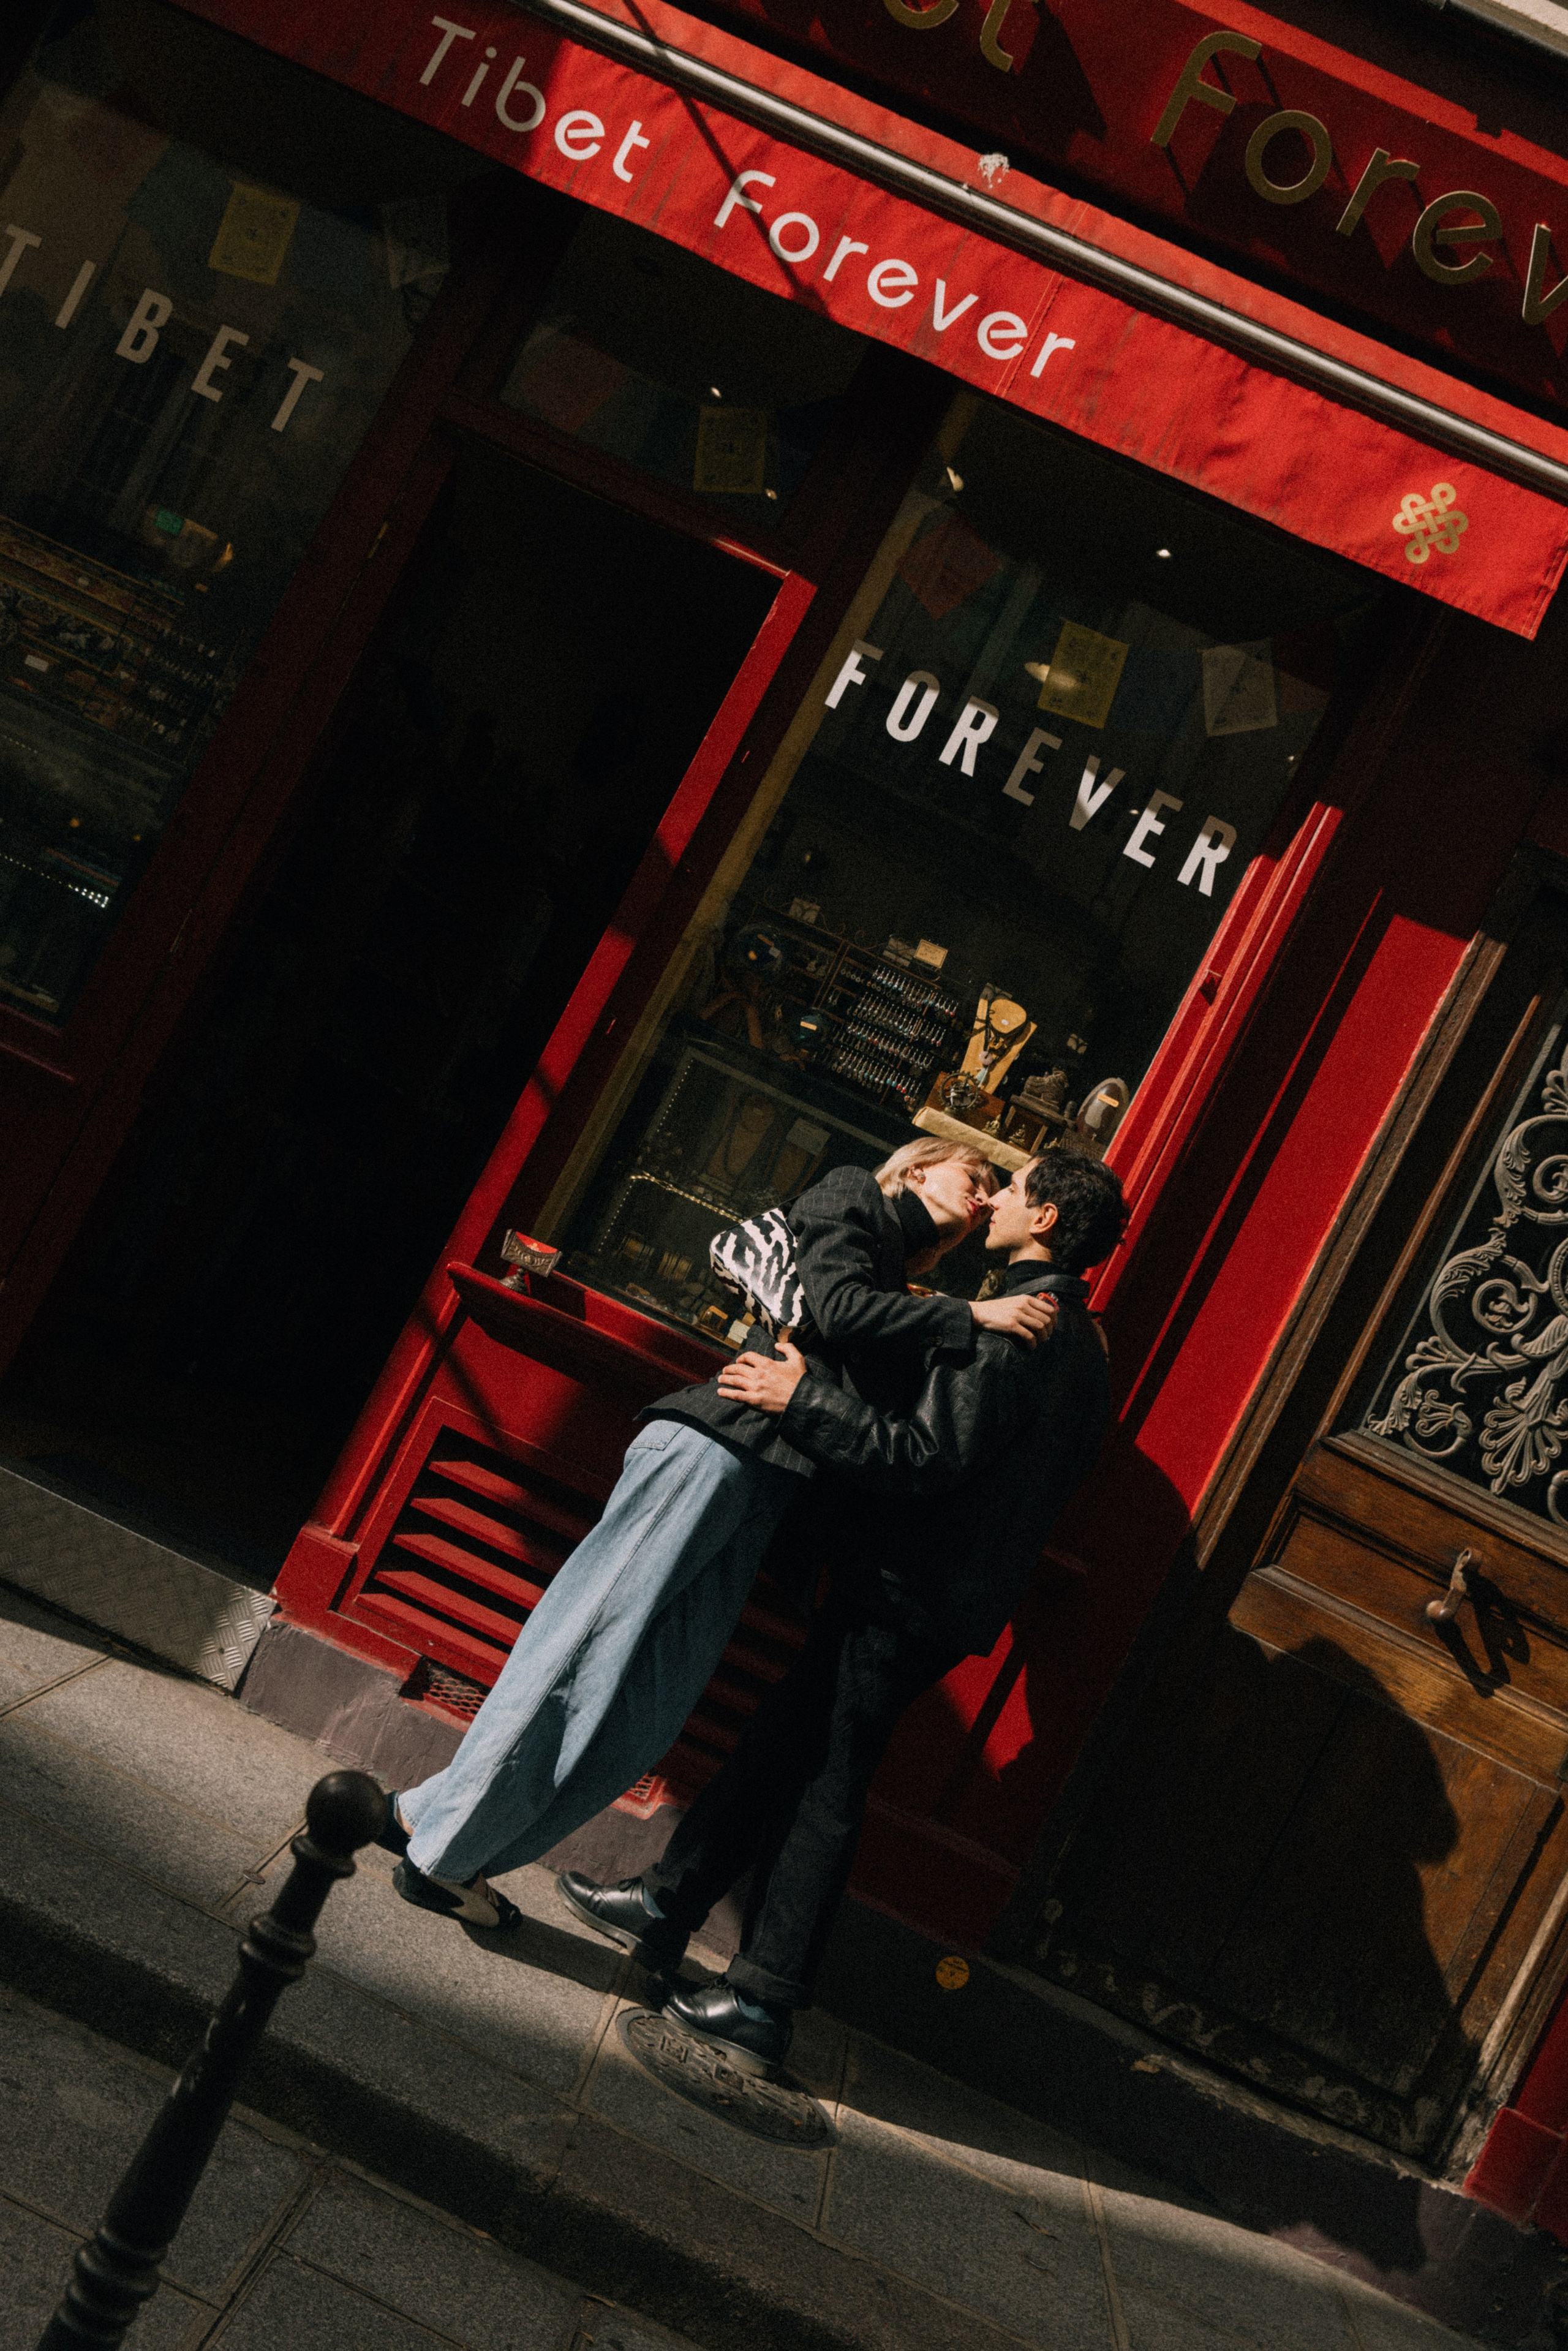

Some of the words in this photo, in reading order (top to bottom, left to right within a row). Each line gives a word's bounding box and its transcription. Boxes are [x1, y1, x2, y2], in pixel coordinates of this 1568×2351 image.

[418, 16, 650, 184] Tibet
[0, 223, 325, 432] TIBET
[824, 639, 1238, 897] FOREVER
